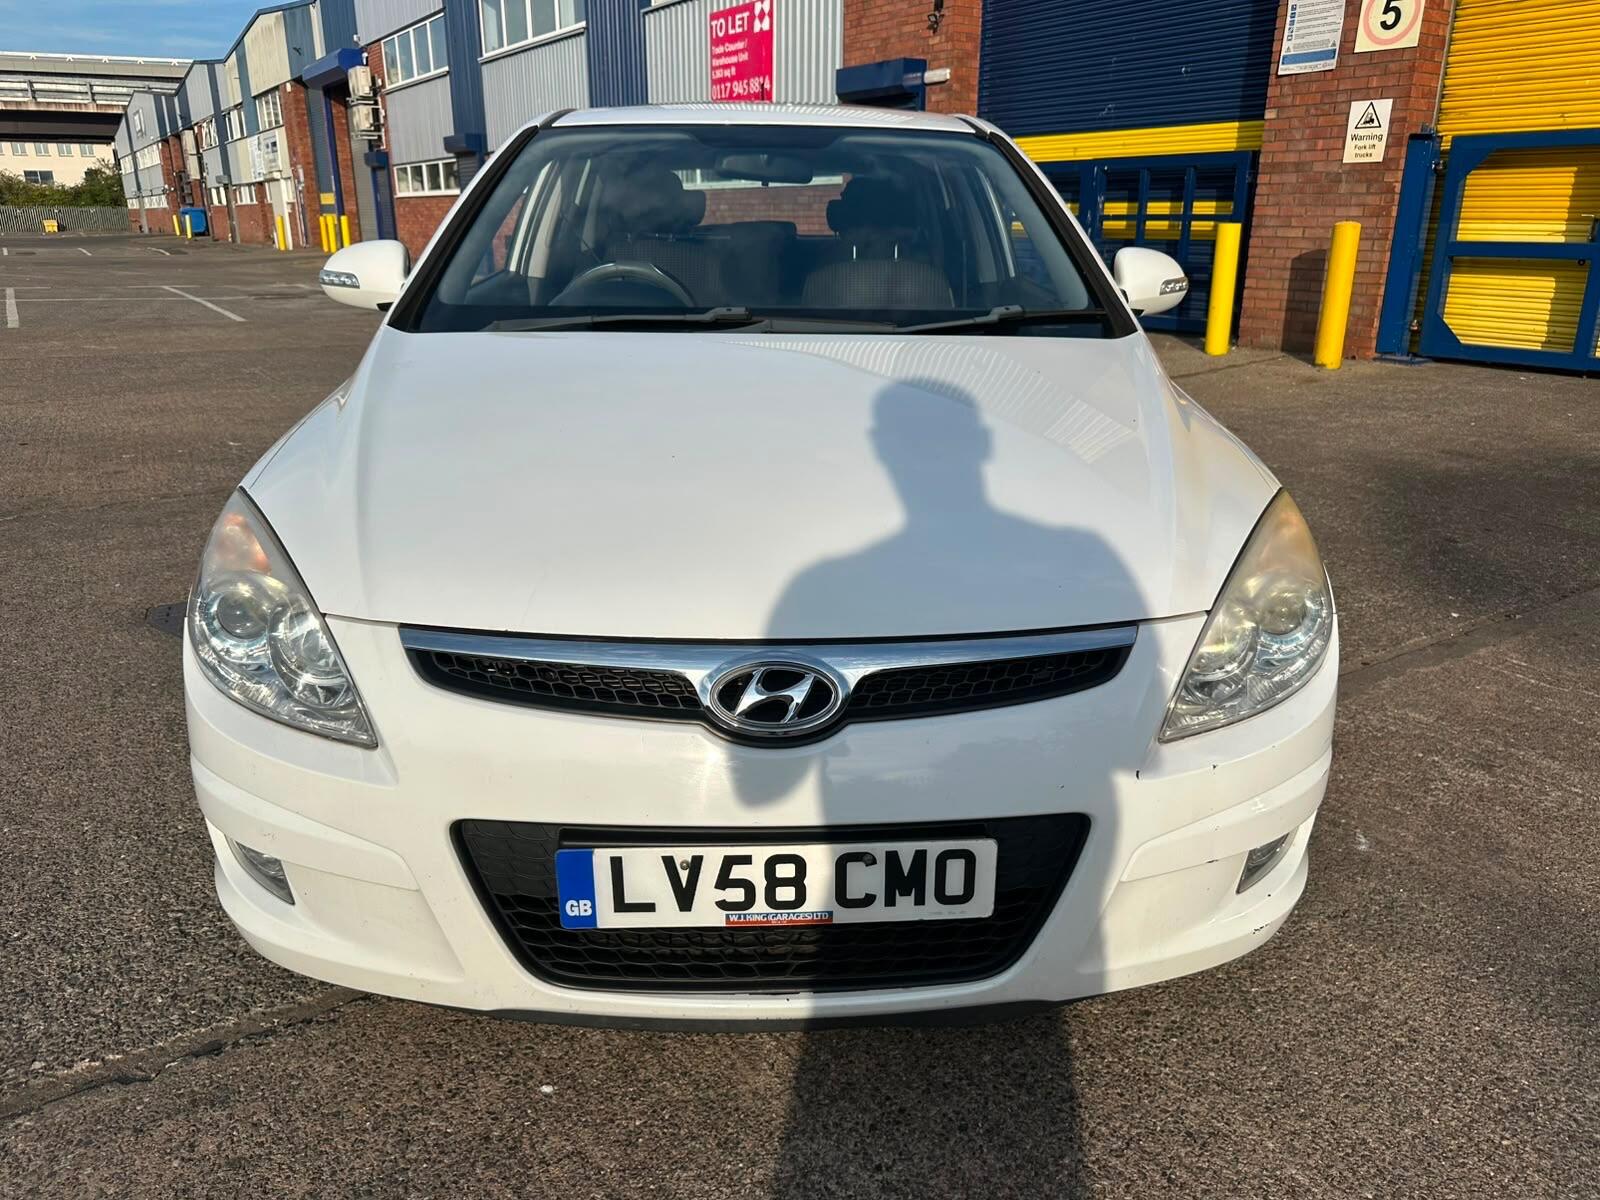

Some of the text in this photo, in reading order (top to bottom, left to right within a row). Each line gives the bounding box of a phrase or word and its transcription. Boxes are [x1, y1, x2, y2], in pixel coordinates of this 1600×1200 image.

[711, 11, 750, 39] TO LET
[1380, 0, 1402, 30] 5
[712, 82, 731, 100] 0117
[732, 78, 749, 97] 945
[1351, 133, 1384, 143] Warning
[609, 848, 977, 913] LV58 CMO
[565, 899, 593, 917] GB
